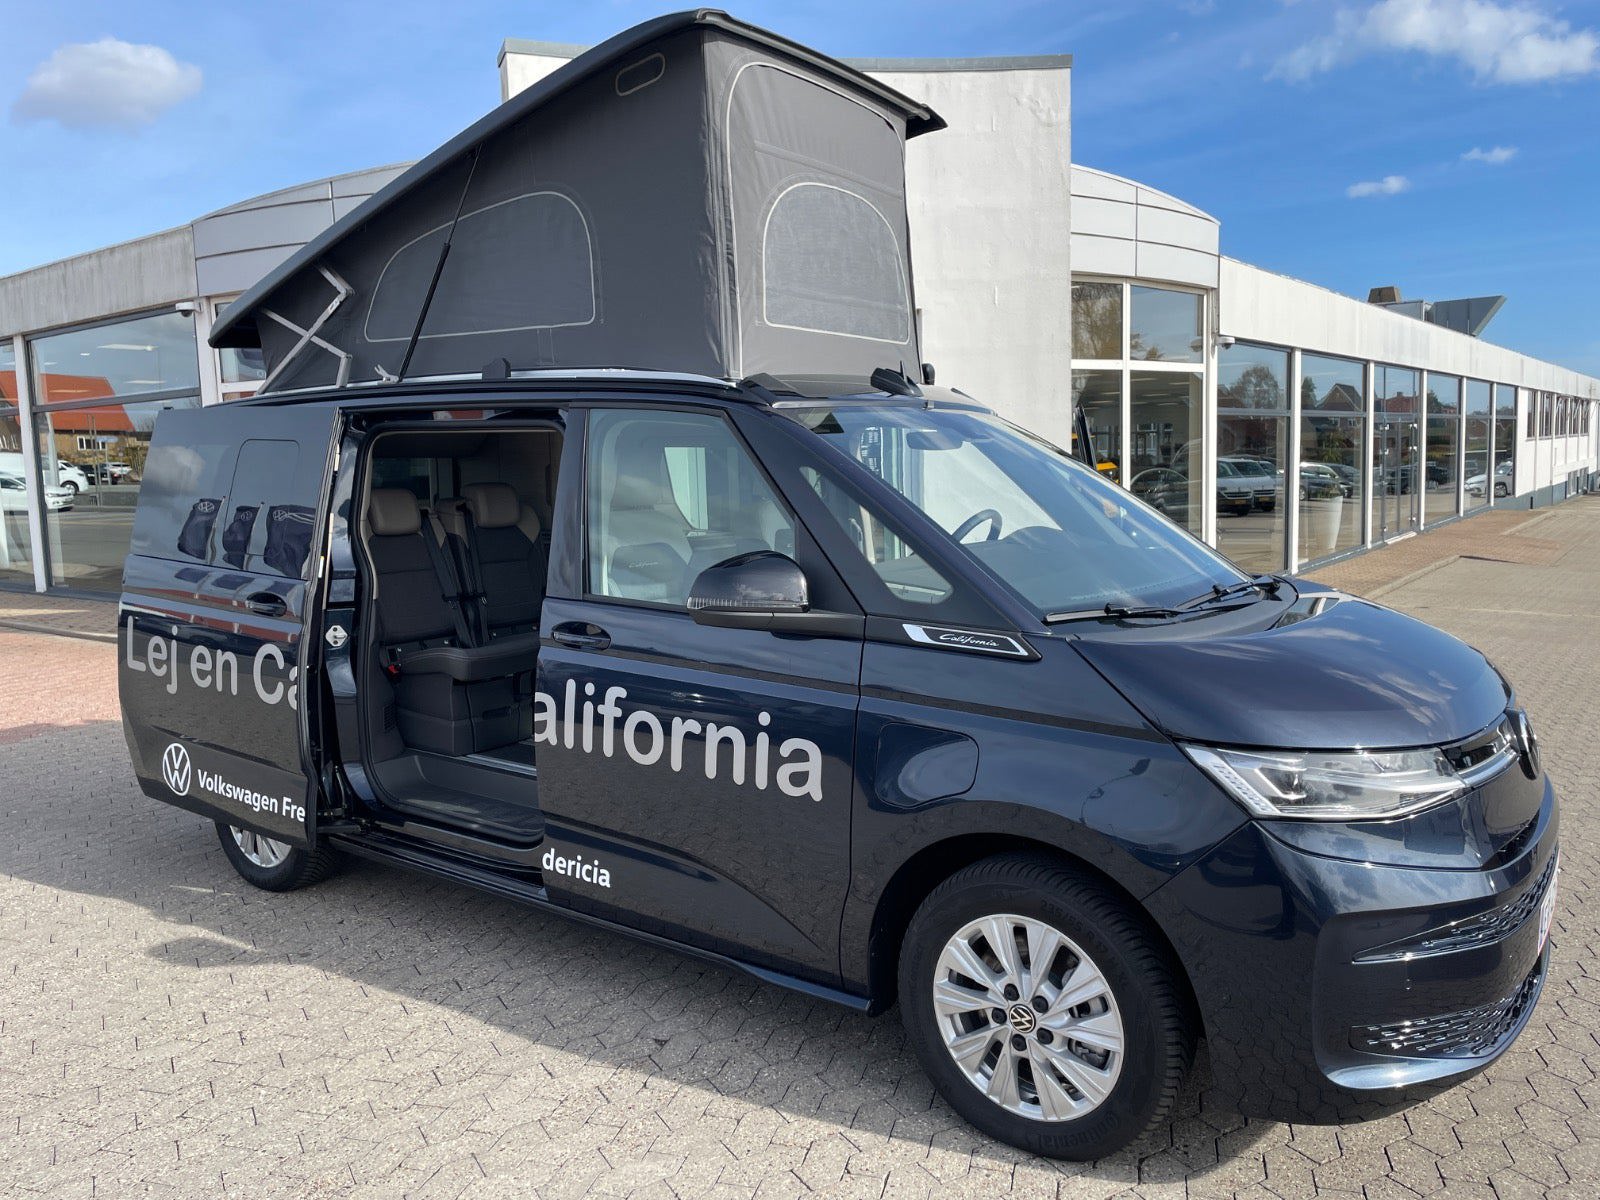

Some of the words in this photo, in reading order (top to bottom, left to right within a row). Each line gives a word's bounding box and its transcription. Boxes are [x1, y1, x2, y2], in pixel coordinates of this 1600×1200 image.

[127, 615, 178, 695] Lej
[190, 646, 238, 696] en
[939, 633, 1000, 647] California
[197, 768, 279, 814] Volkswagen
[282, 796, 306, 822] Fre
[542, 848, 611, 888] dericia
